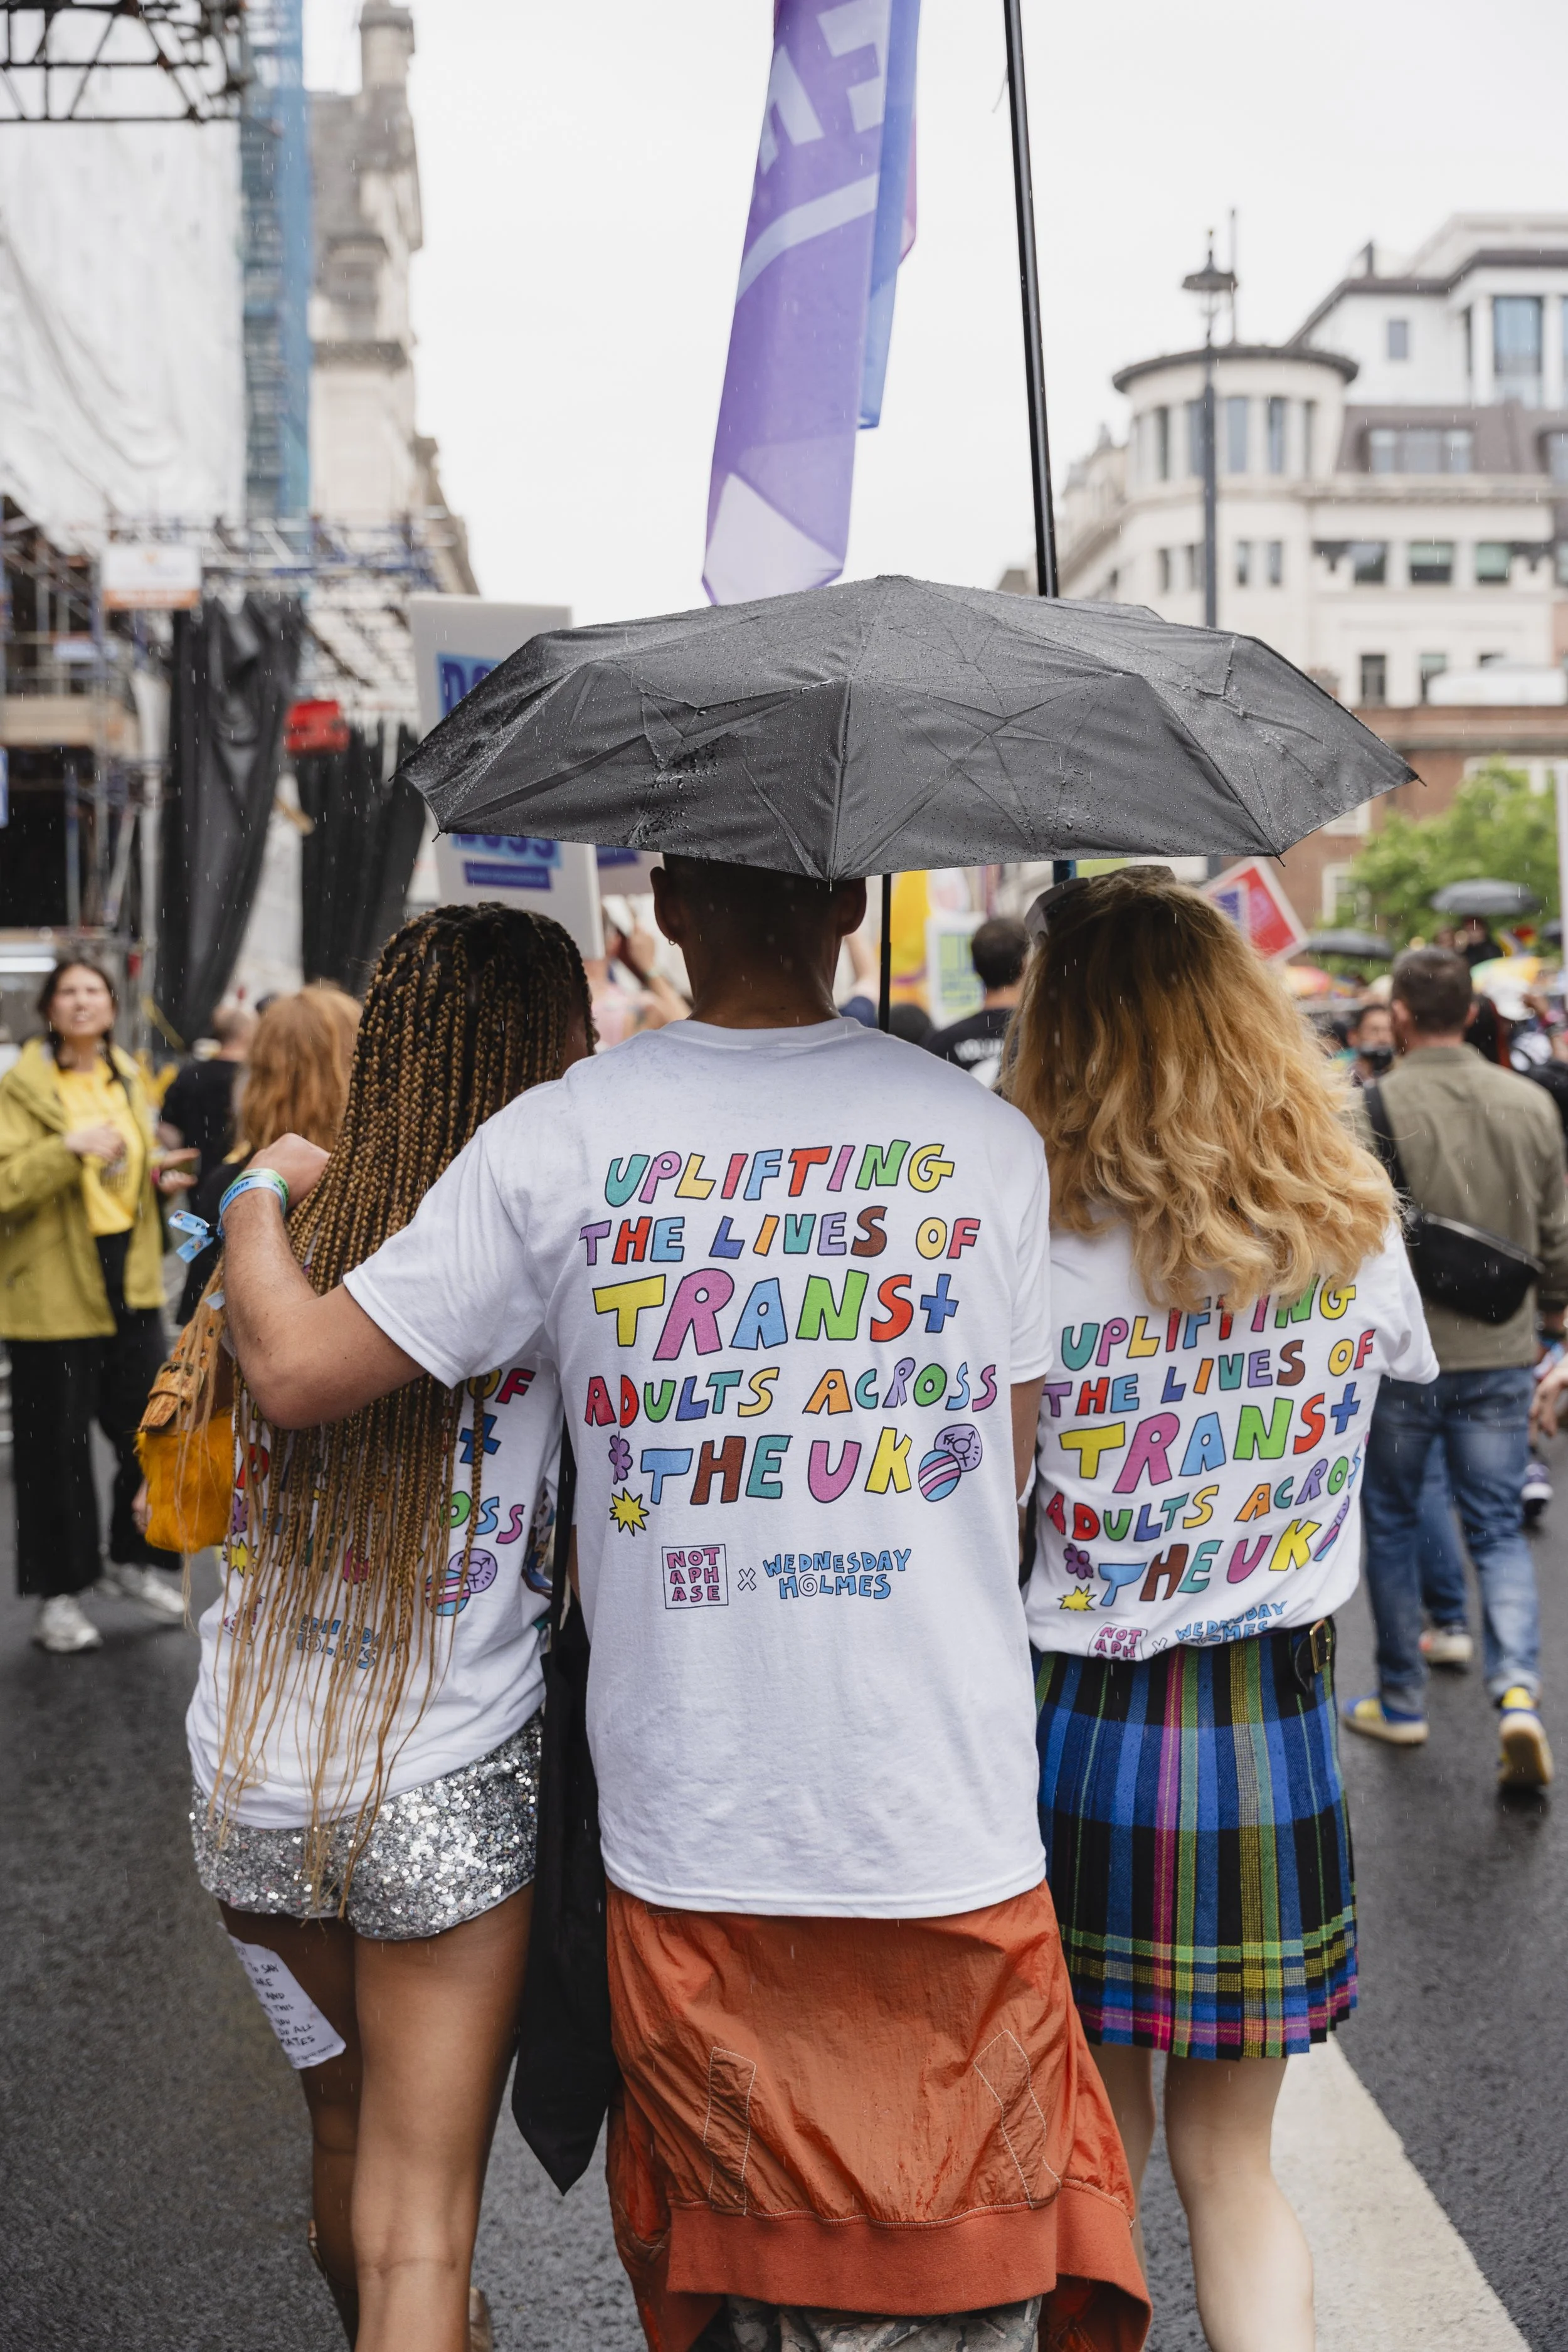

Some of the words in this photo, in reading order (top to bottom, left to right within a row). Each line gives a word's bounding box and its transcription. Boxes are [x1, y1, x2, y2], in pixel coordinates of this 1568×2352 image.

[604, 1140, 955, 1207] UPLIFTING
[578, 1216, 685, 1266] THE
[709, 1205, 888, 1259] LIVES
[915, 1217, 981, 1260] OF
[592, 1268, 959, 1361] TRANS+
[585, 1367, 780, 1428] ADULTS
[802, 1357, 998, 1415] ACROSS
[1042, 1373, 1140, 1417] THE
[1160, 1339, 1306, 1404] LIVES
[1328, 1328, 1377, 1377] OF
[640, 1434, 794, 1506] THE
[807, 1426, 913, 1504] UK
[1059, 1382, 1361, 1494] TRANS+
[1046, 1484, 1221, 1542] ADULTS
[1234, 1431, 1370, 1523] ACROS
[666, 1547, 722, 1568] NOT
[669, 1567, 718, 1586] APH
[763, 1548, 912, 1579] WEDNESDAY
[779, 1574, 891, 1600] HOLMES
[1098, 1540, 1224, 1607] THE
[1226, 1518, 1322, 1585] UK
[672, 1586, 721, 1602] ASE
[1094, 1638, 1136, 1658] APH
[1099, 1626, 1142, 1645] NOT
